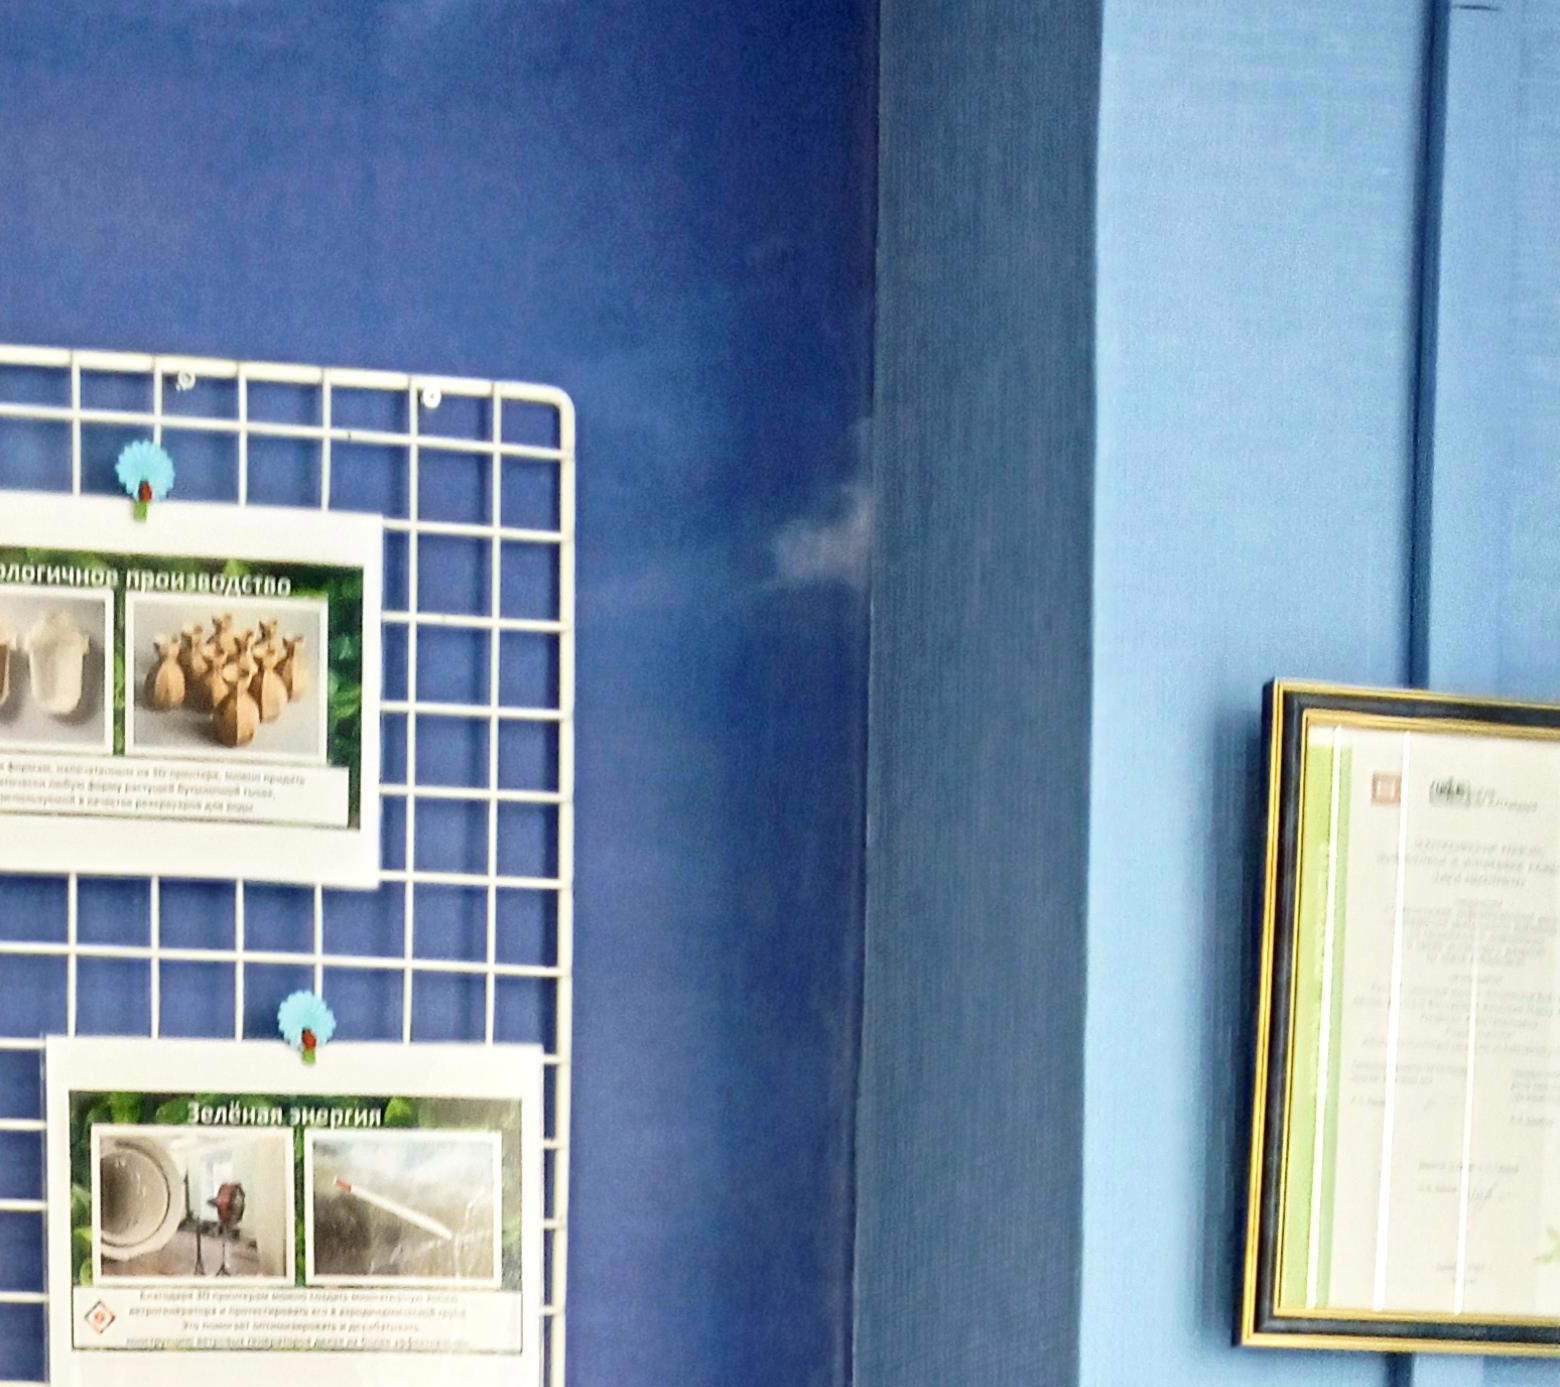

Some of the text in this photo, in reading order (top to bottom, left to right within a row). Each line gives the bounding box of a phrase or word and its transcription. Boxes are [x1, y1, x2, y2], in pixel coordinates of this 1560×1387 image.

[125, 568, 291, 598] производство
[187, 1099, 382, 1130] Зелёная энергия
